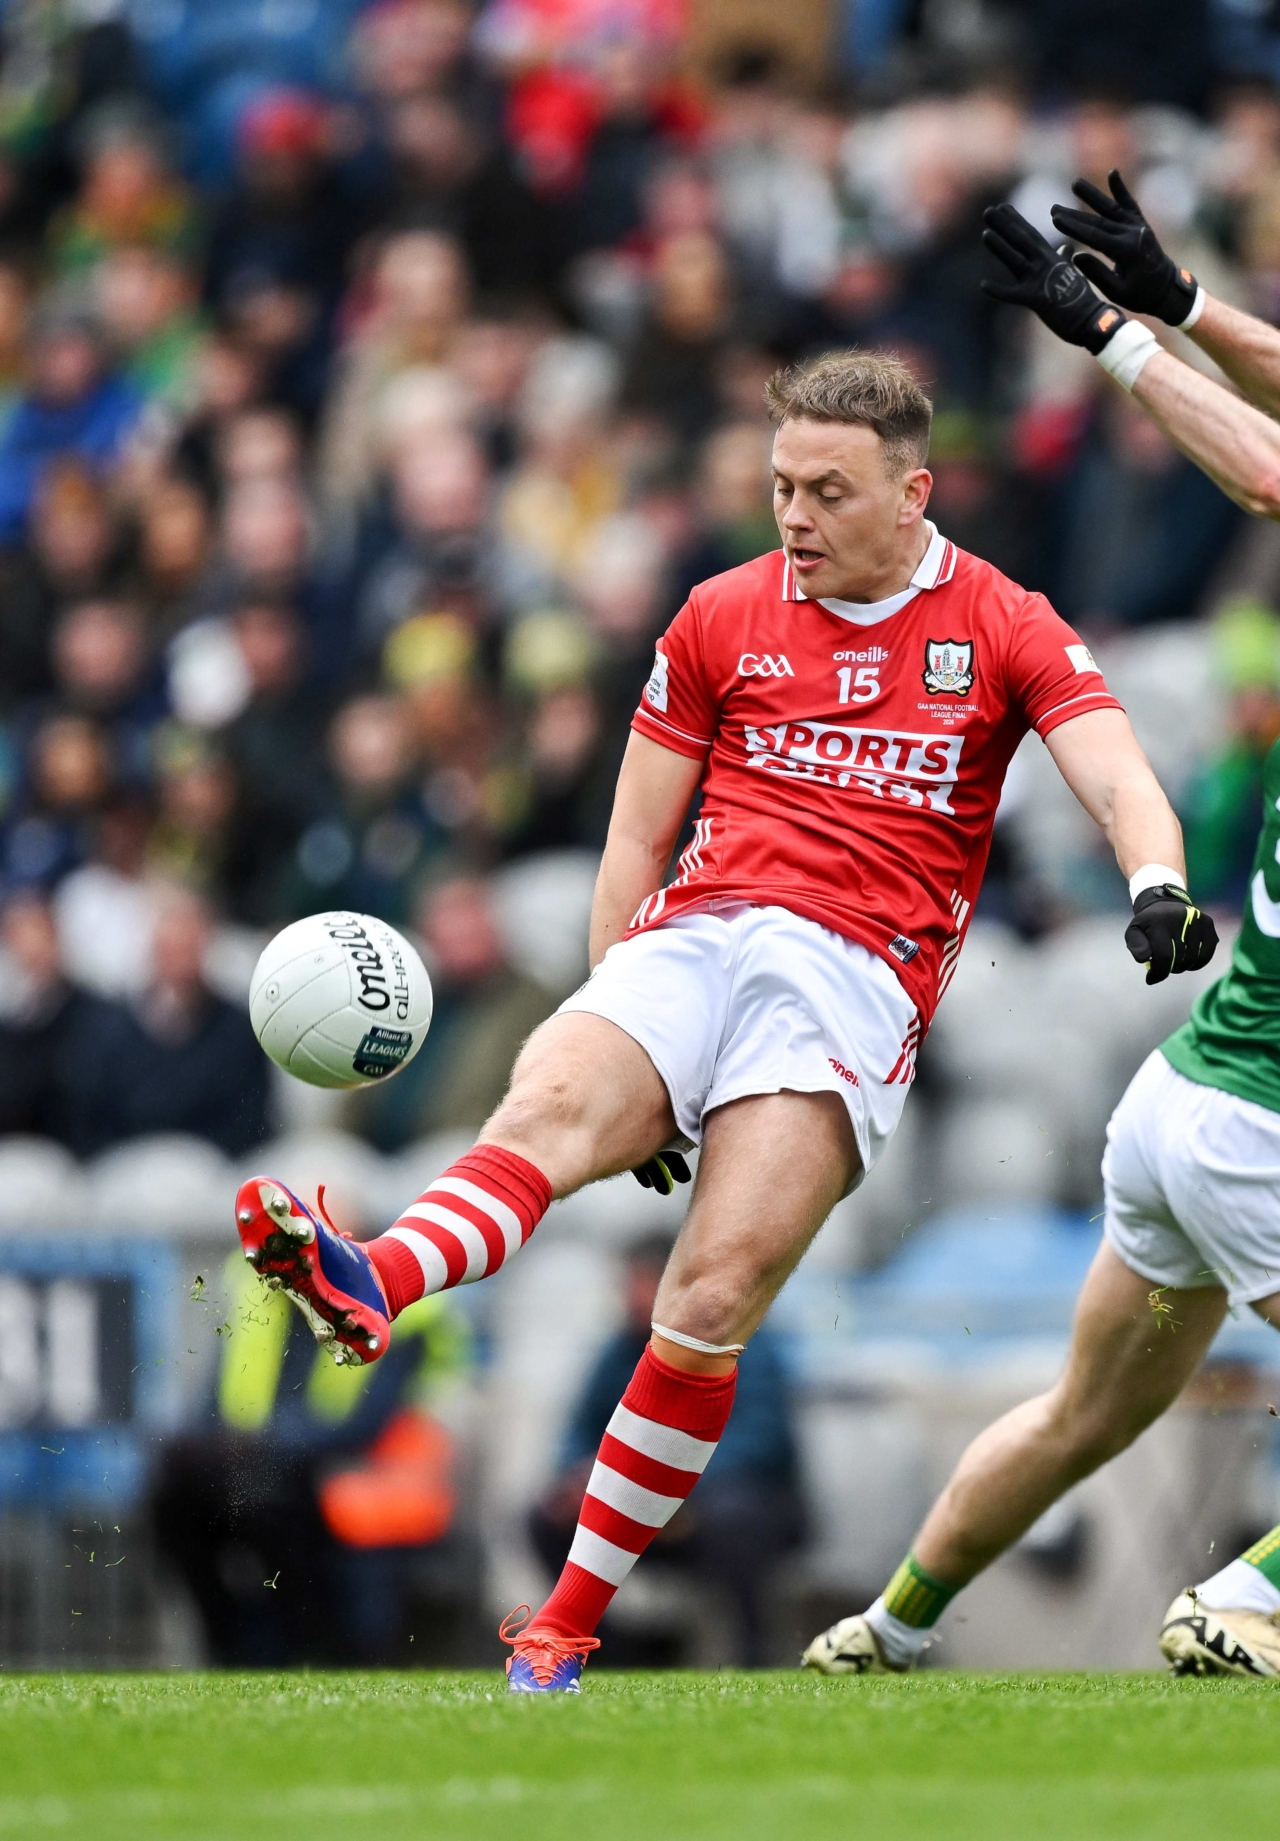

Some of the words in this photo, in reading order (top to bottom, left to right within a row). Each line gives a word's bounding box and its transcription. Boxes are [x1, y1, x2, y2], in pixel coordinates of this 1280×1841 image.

[737, 653, 795, 678] GAA
[836, 667, 881, 704] 15
[929, 703, 954, 711] NATIONAL
[954, 704, 979, 712] FOOTBALL
[755, 724, 951, 775] SPORTS
[362, 1040, 407, 1059] LEAGUES
